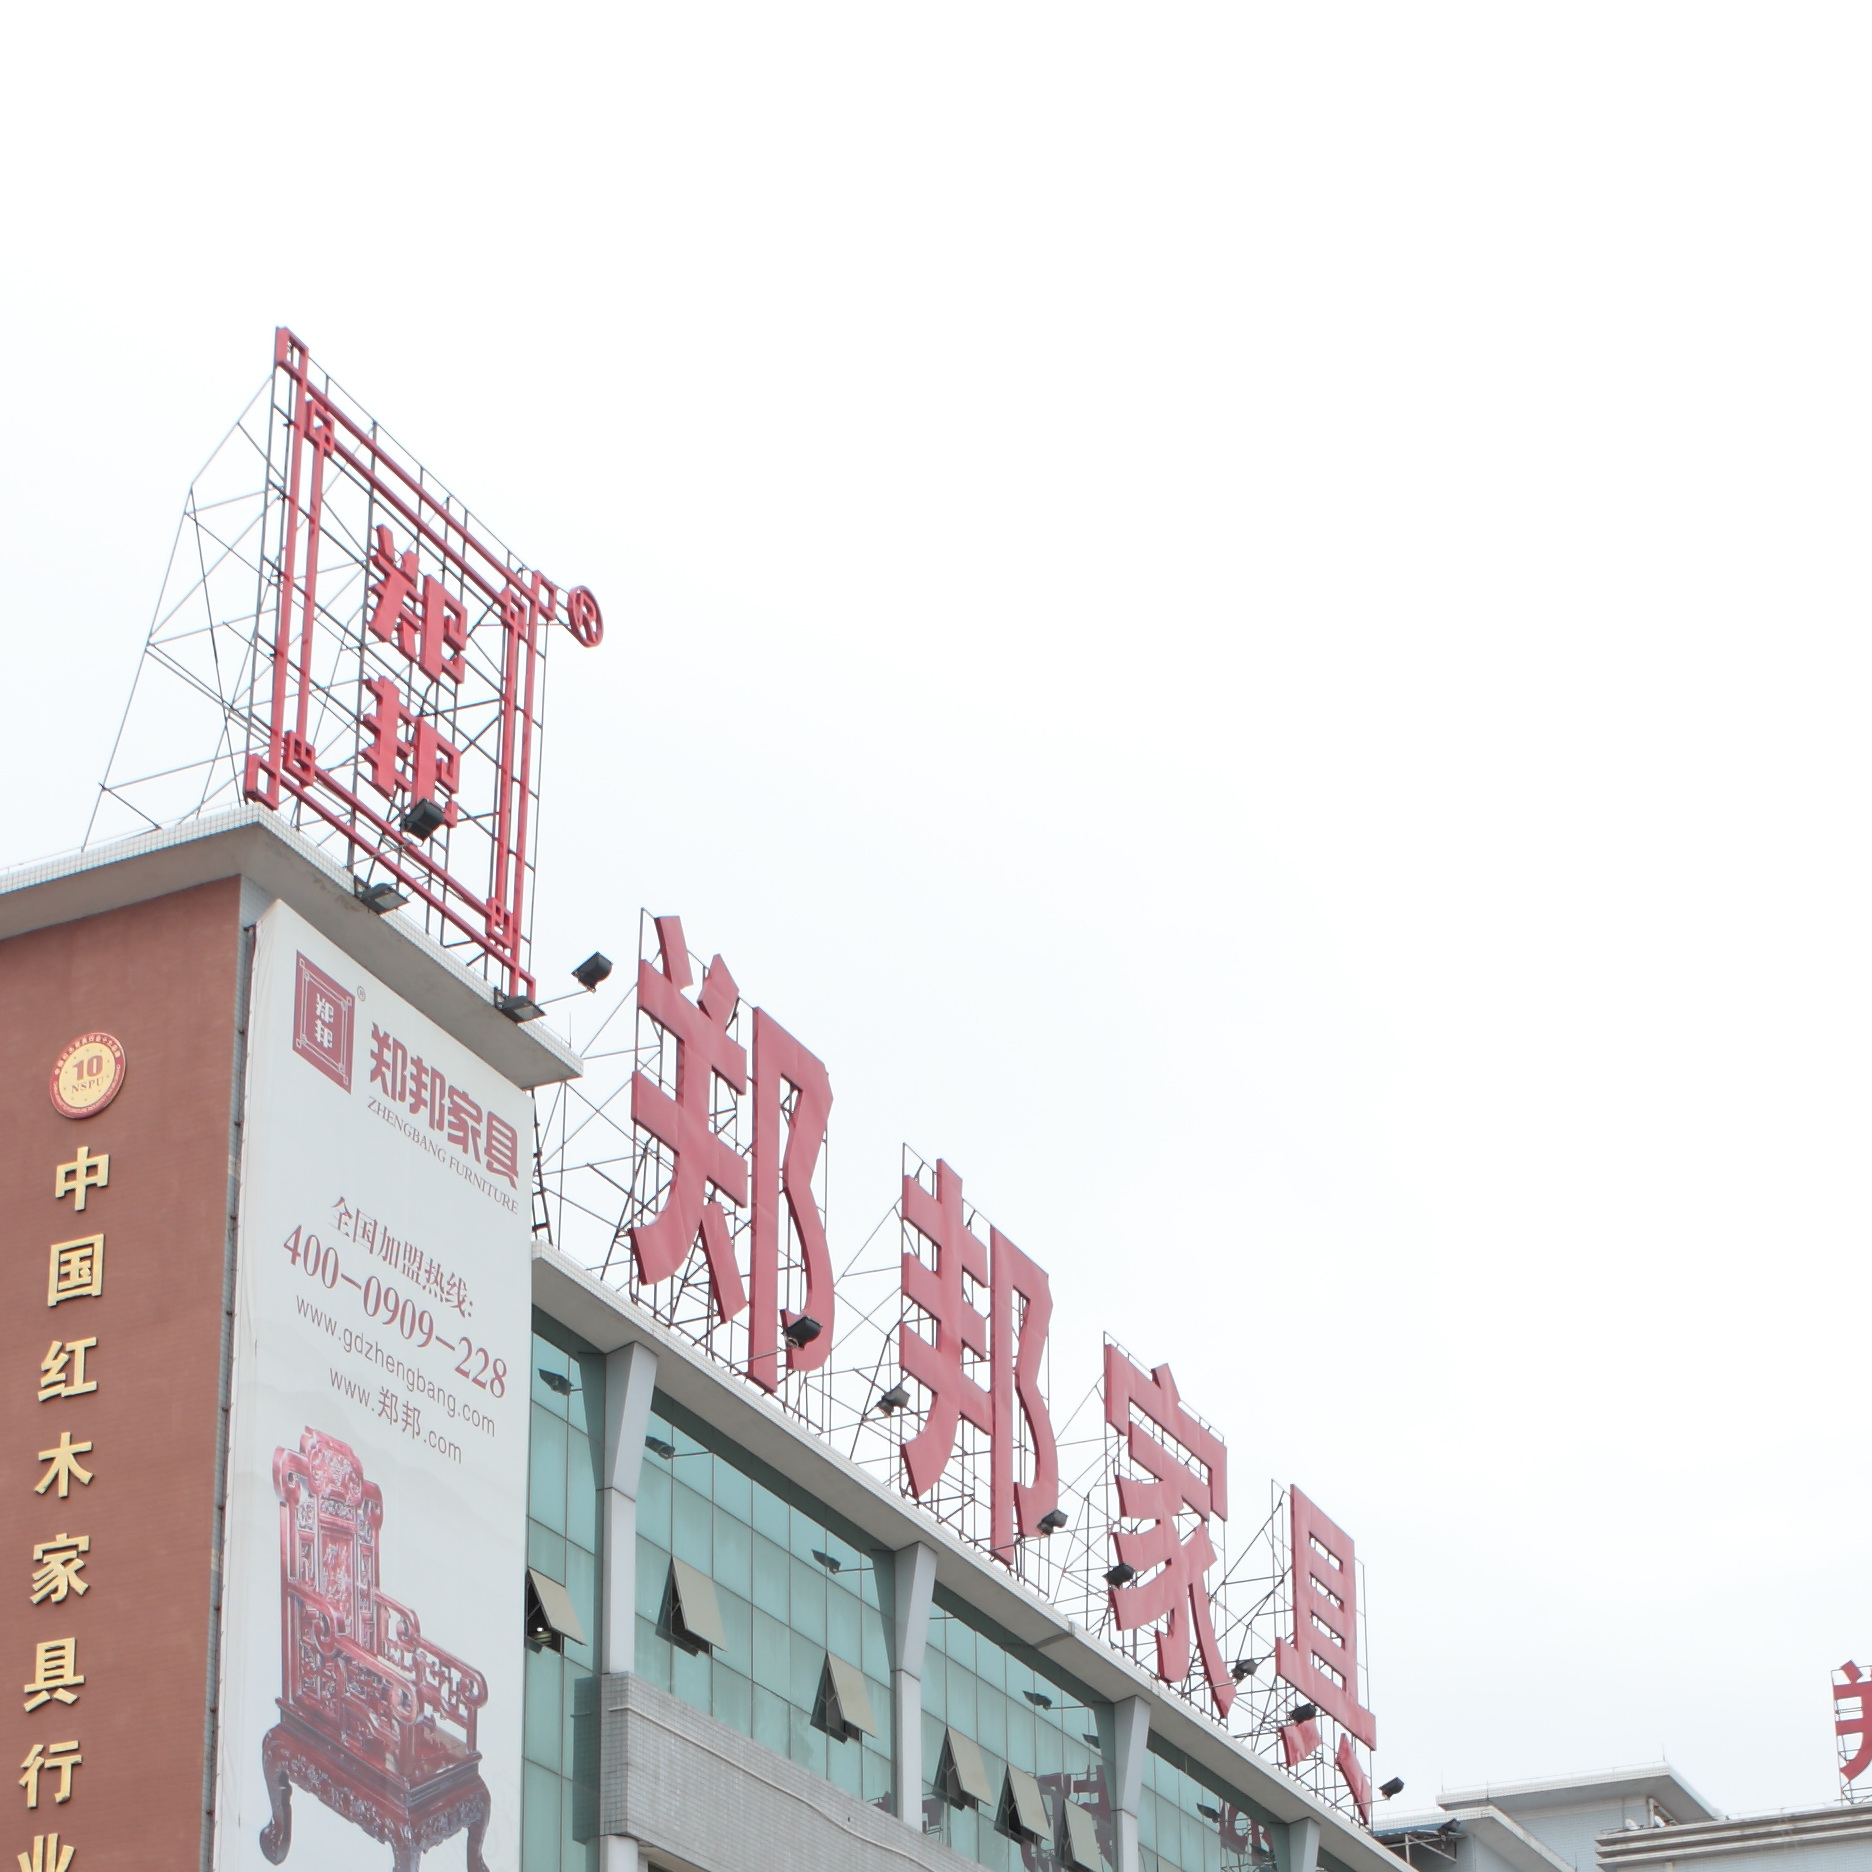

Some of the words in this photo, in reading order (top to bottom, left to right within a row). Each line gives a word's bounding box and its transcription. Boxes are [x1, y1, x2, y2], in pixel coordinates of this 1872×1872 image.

[362, 524, 467, 830] 郑邦
[72, 1054, 104, 1082] 10
[368, 1022, 520, 1190] 郑邦家具
[367, 1095, 446, 1166] ZHENGBANG
[448, 1157, 519, 1216] FURNITURE
[283, 1223, 507, 1400] 400-0909-228
[330, 1195, 474, 1319] 全国加盟热线:
[296, 1294, 496, 1438] www.gdzhengbang.com
[329, 1366, 462, 1464] www.郑邦.com
[627, 915, 1378, 1824] 郑邦家具
